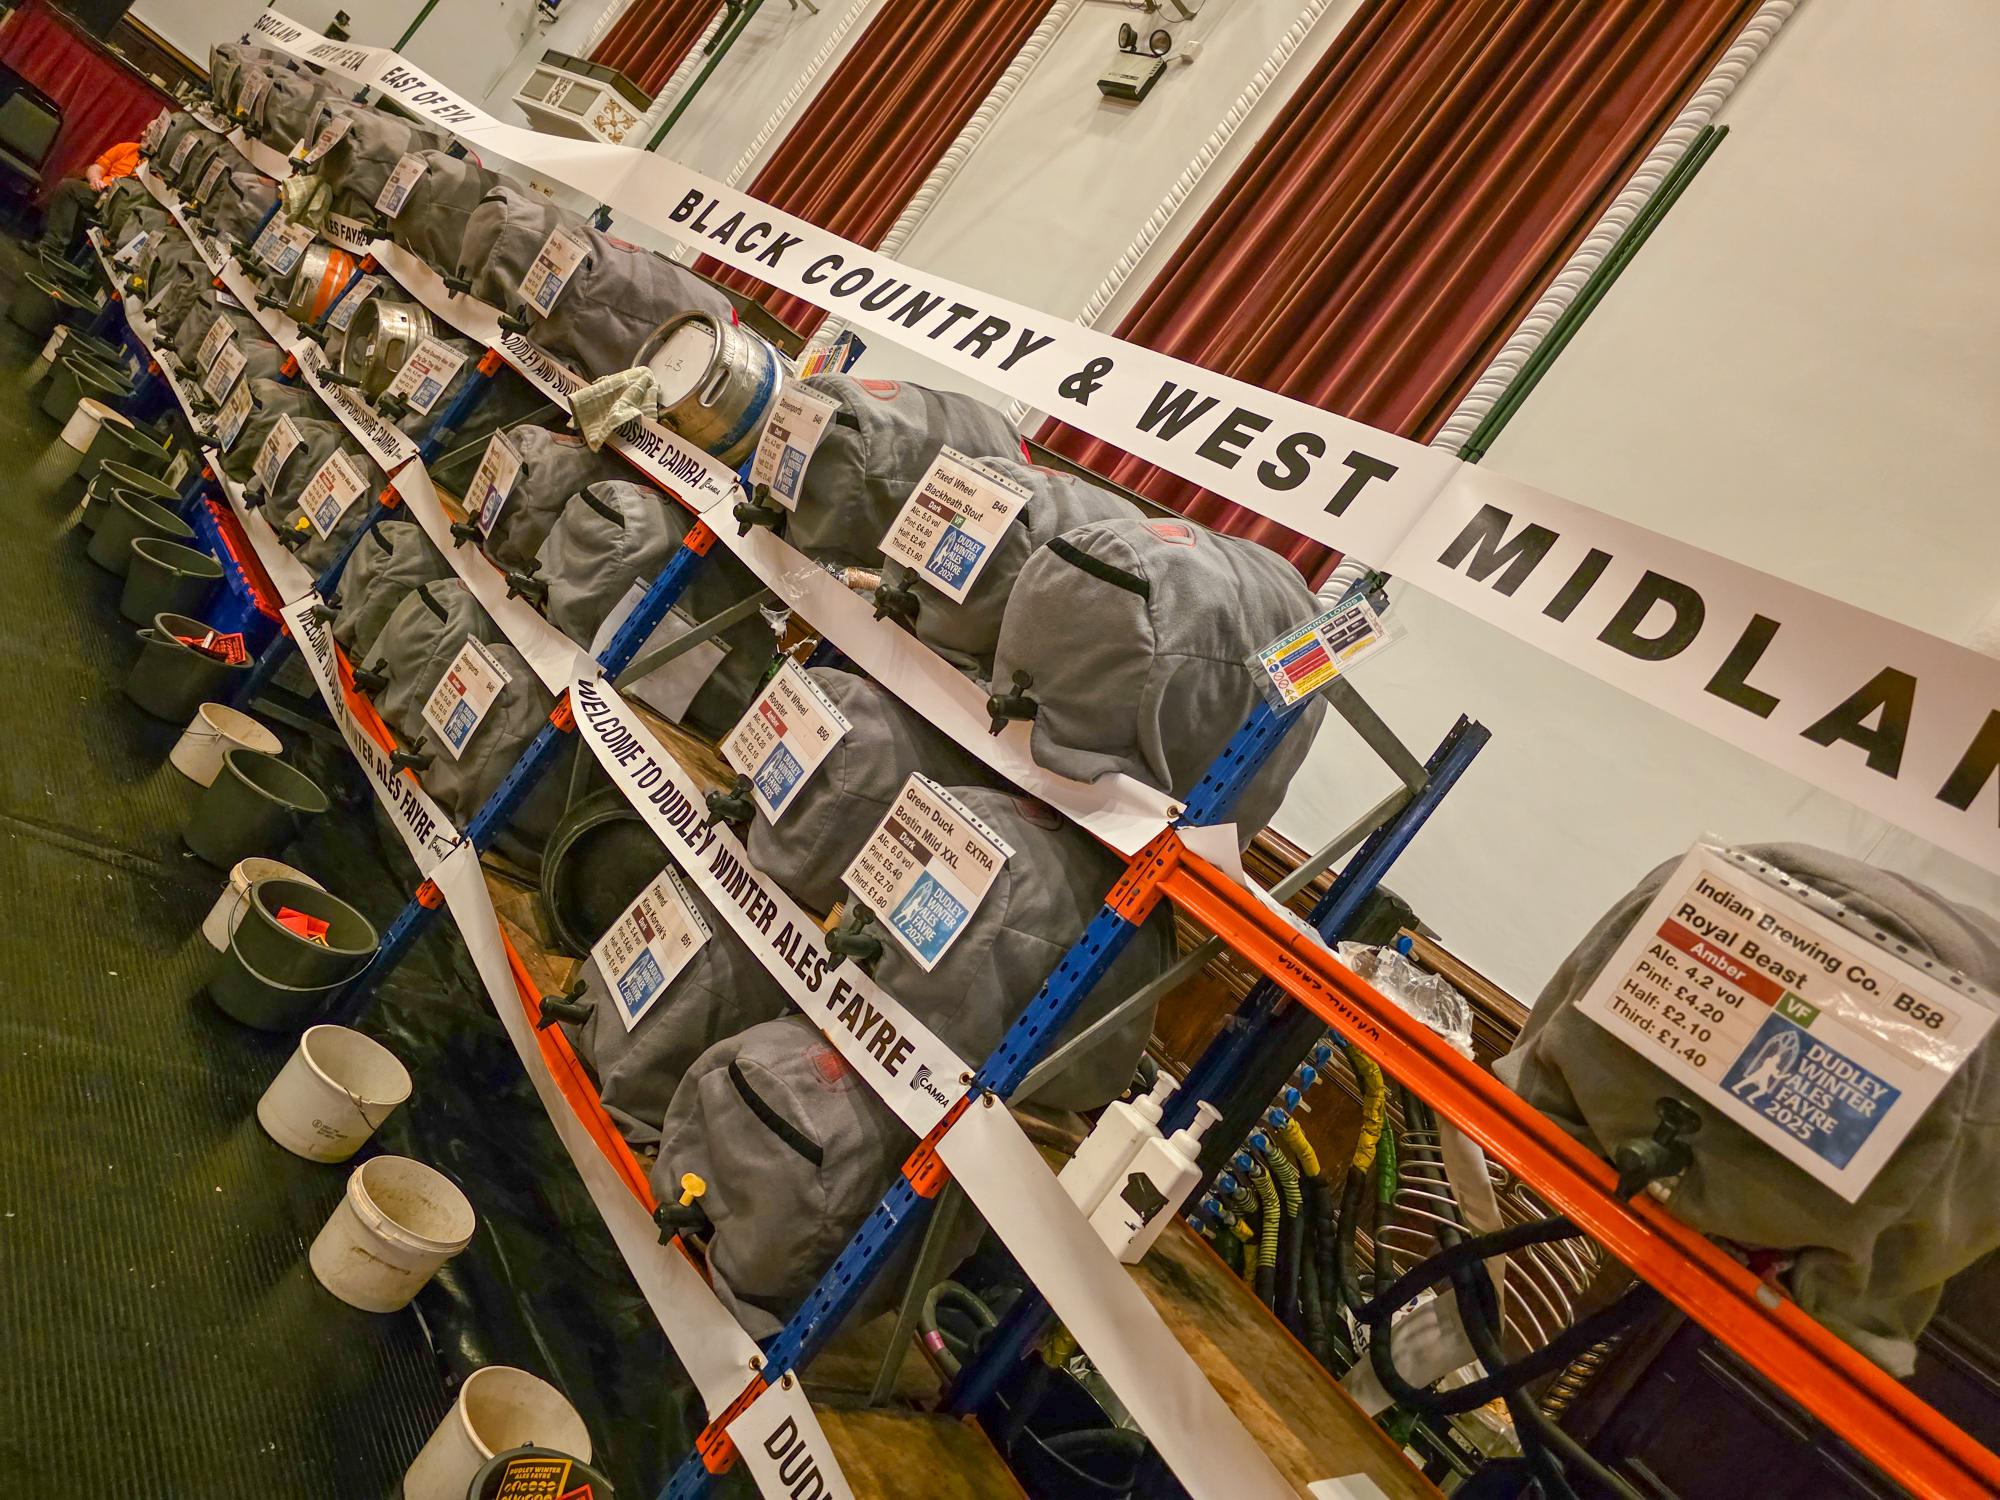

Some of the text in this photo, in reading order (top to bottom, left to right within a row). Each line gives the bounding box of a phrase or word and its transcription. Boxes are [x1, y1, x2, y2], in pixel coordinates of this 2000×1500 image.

[254, 14, 302, 43] SCOTLAND
[380, 67, 475, 123] EAST OF EYA
[668, 188, 805, 271] BLACK
[800, 252, 1056, 372] COUNTRY
[1058, 355, 1115, 407] &
[1135, 379, 1400, 519] WEST
[502, 336, 543, 367] DUDLEY
[532, 360, 557, 383] AND
[552, 377, 585, 397] SOUT
[658, 445, 707, 488] CAMRA
[372, 426, 400, 456] CAMRA
[925, 483, 984, 522] Blackheath Stout
[928, 500, 942, 514] Dark
[934, 468, 1008, 514] Fixed Wheel B49
[904, 516, 932, 537] Pint: £4.80
[910, 506, 941, 528] Alc. 5.0 vol
[954, 516, 963, 525] VF
[892, 537, 923, 561] Third: £1.60
[898, 527, 926, 549] Half: £2.40
[953, 543, 977, 563] WINTER
[958, 534, 982, 554] DUDLEY
[938, 567, 954, 582] 2025
[943, 558, 963, 575] FAYRE
[947, 551, 963, 565] ALES
[1266, 644, 1287, 656] SAFE
[1288, 616, 1328, 642] WORKING
[1330, 599, 1358, 618] LOADS
[768, 692, 788, 717] Rooster
[777, 678, 830, 742] Fixed Wheel B50
[753, 712, 774, 740] Alc. 4.5 vol
[753, 732, 766, 749] £4.20
[741, 754, 754, 772] £1.40
[746, 742, 759, 759] £2.10
[782, 753, 803, 777] DUDLEY
[777, 760, 796, 785] WINTER
[376, 757, 402, 802] ALES
[400, 789, 435, 846] FAYRE
[761, 783, 775, 799] 2025
[895, 805, 959, 870] Bostin Mild XXL
[899, 832, 915, 851] Dark
[906, 788, 994, 872] Green Duck EXTRA
[868, 844, 903, 881] Pint: £5.40
[877, 833, 915, 870] Alc. 6.0 vol
[577, 679, 916, 1079] WELCOME TO DUDLEY WINTER ALES FAYRE
[850, 868, 888, 909] Third: £1.80
[859, 856, 894, 893] Half: £2.70
[641, 897, 668, 941] King Korvak's
[653, 884, 692, 949] Fownd B51
[918, 906, 940, 927] ALES
[927, 897, 957, 929] WINTER
[933, 887, 964, 917] DUDLEY
[638, 917, 647, 932] Dark
[905, 925, 926, 947] 2025
[913, 914, 937, 941] FAYRE
[1677, 902, 1808, 990] Royal Beast
[1690, 941, 1747, 982] Amber
[1695, 878, 1945, 1031] Indian Brewing Co. B58
[1636, 960, 1725, 1024] Pint: £4.20
[1648, 943, 1745, 1009] Alc. 4.2 vol
[1623, 978, 1712, 1043] Half: £2.10
[1785, 999, 1812, 1020] VF
[1610, 995, 1707, 1068] Third: £1.40
[1799, 1059, 1878, 1118] WINTER
[1806, 1043, 1888, 1102] DUDLEY
[918, 1076, 950, 1109] CAMRA
[1785, 1073, 1834, 1111] ALES
[1764, 1101, 1815, 1140] 2025
[1775, 1088, 1838, 1135] FAYRE
[763, 1414, 832, 1500] DUD
